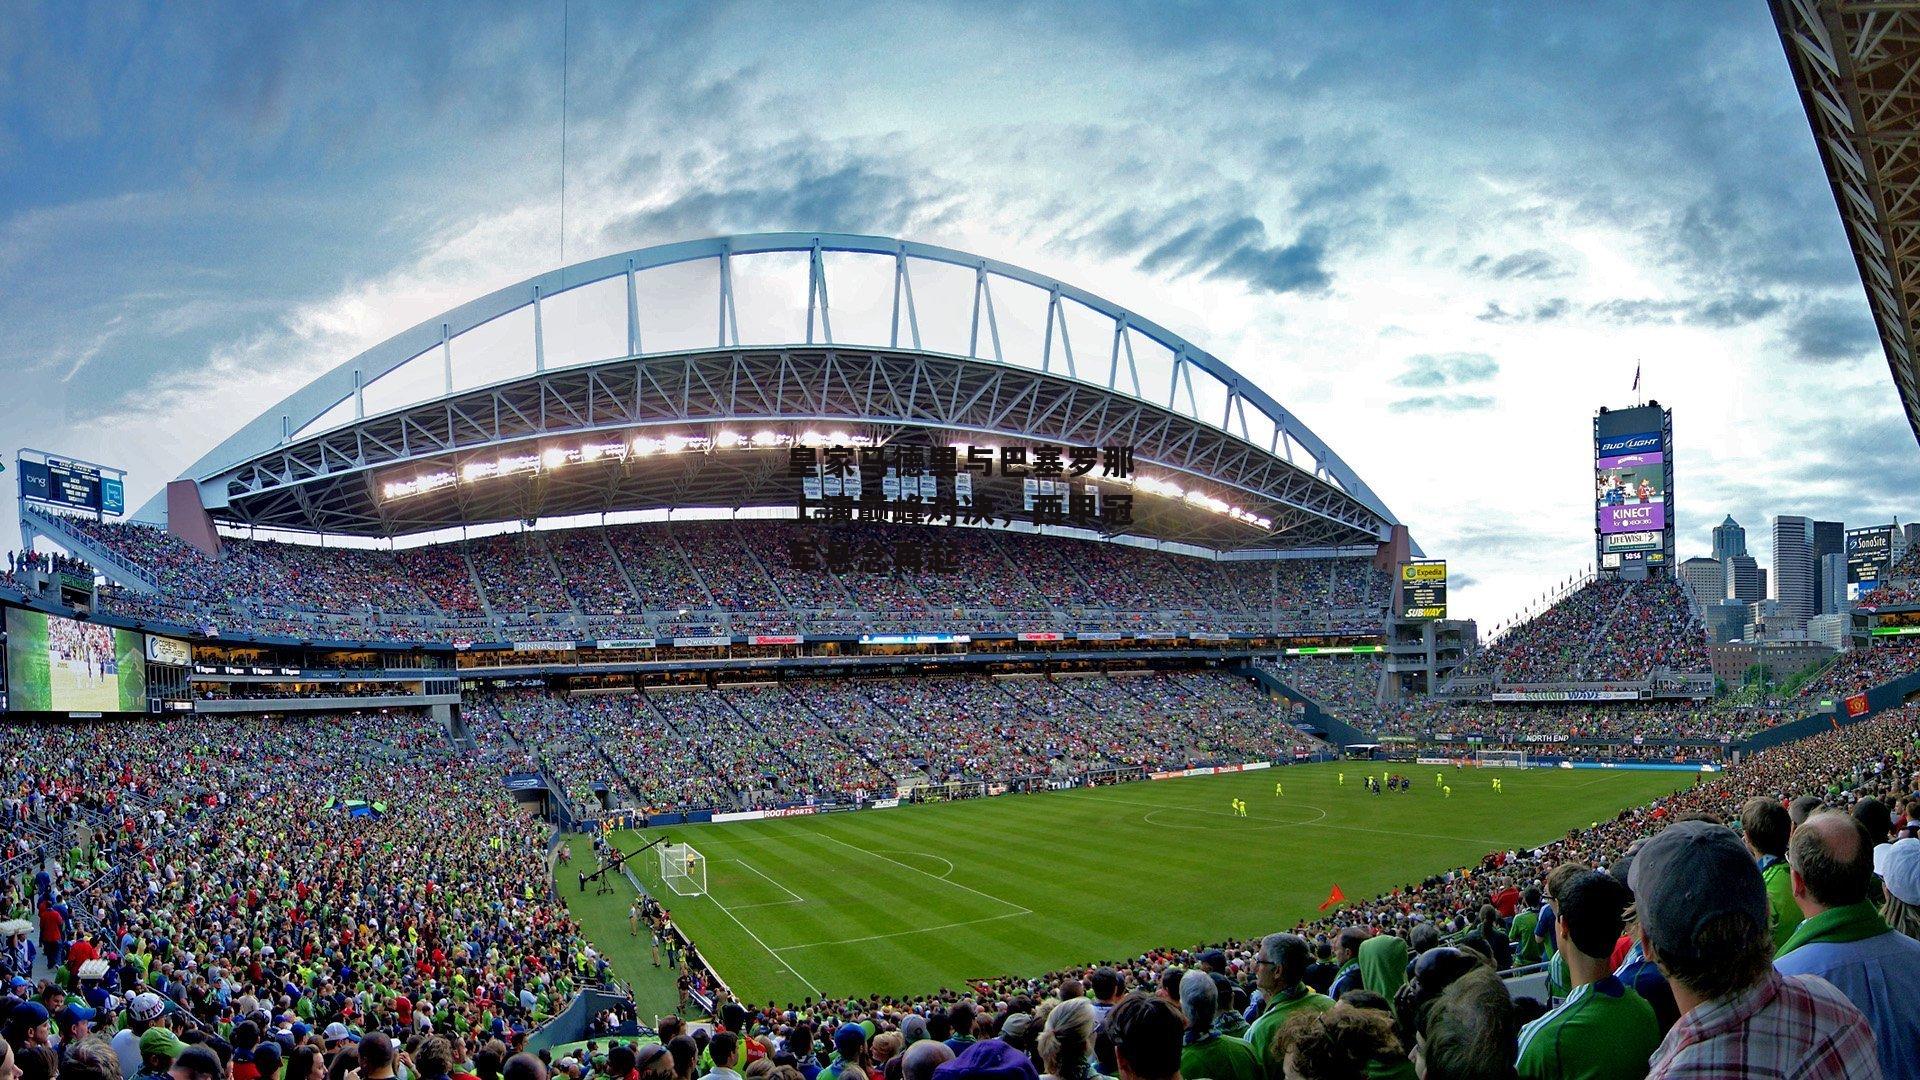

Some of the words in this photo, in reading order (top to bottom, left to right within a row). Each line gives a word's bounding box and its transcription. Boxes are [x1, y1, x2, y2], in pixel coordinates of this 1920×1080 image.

[1628, 439, 1658, 447] LIGHT
[26, 474, 46, 487] bing
[1613, 507, 1652, 519] KINECT
[1858, 536, 1886, 548] SonoSite
[1416, 569, 1442, 577] Expedia
[1405, 608, 1444, 617] SUBWAY
[518, 643, 564, 651] PINNACLE
[764, 809, 785, 818] ROOT
